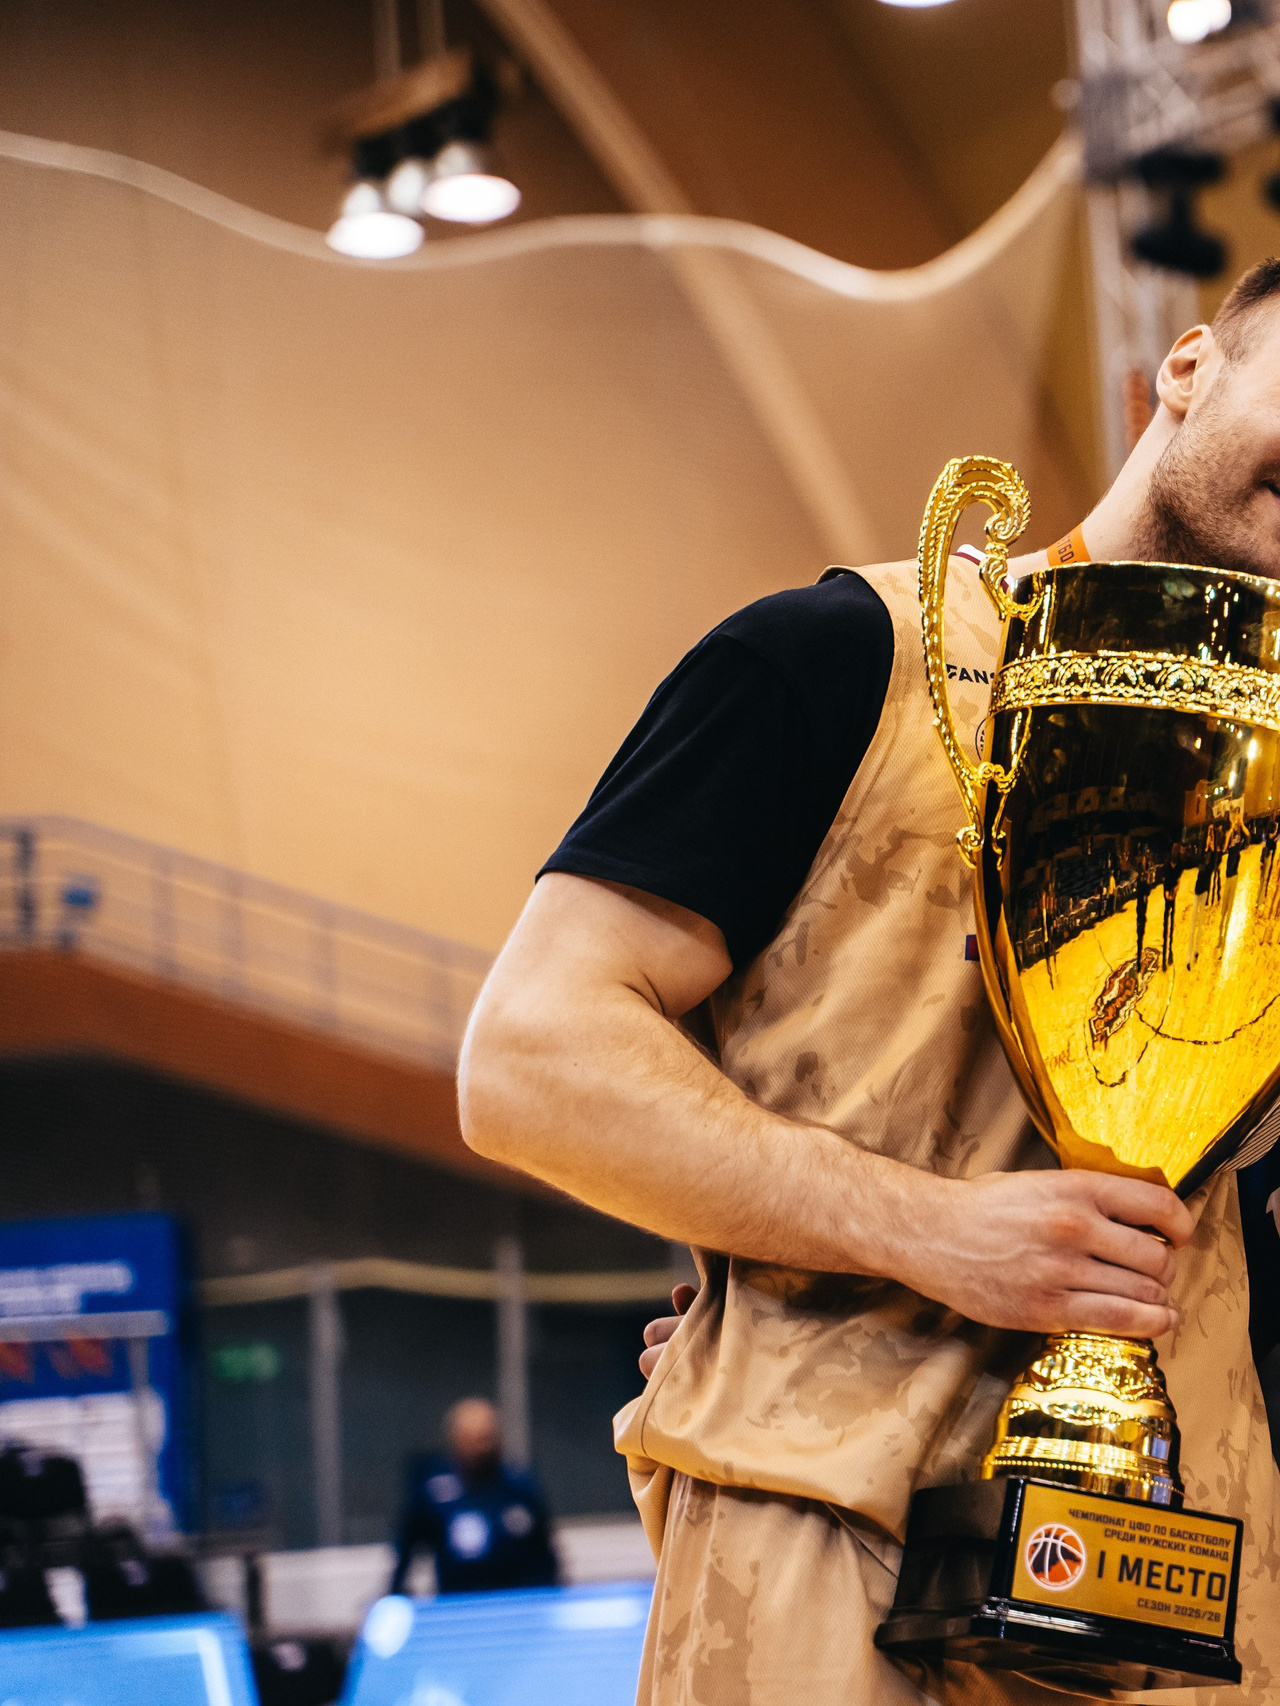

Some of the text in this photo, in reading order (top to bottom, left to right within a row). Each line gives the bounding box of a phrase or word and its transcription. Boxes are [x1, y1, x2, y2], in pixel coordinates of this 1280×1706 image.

[946, 663, 994, 685] FAN
[1069, 1508, 1232, 1549] ЧЕМПИОНАТ ЦФО ПО БАСКЕТБОЛУ
[1104, 1528, 1229, 1562] СРЕДИ МУЖСКИХ КОМАНД
[1118, 1553, 1227, 1602] МЕСТО
[1137, 1597, 1171, 1613] СЕЗОН
